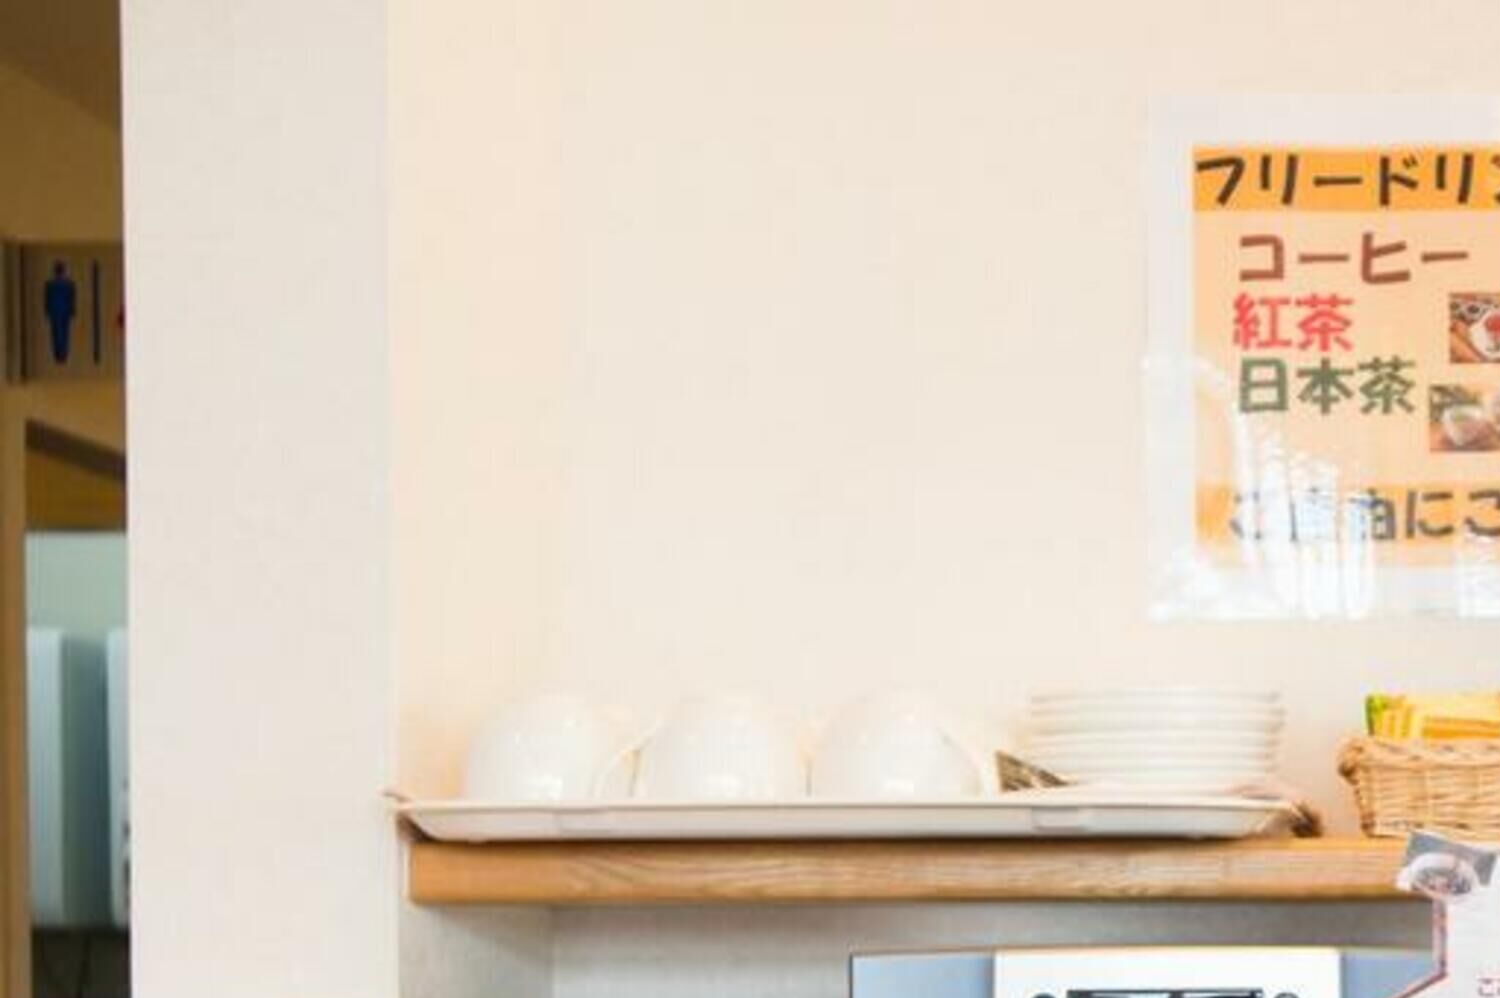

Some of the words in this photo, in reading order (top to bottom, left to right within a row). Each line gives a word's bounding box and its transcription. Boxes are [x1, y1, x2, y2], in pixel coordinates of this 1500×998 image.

[1239, 232, 1469, 285] コーヒー
[1233, 292, 1354, 352] 紅茶
[1238, 356, 1416, 415] 日本茶
